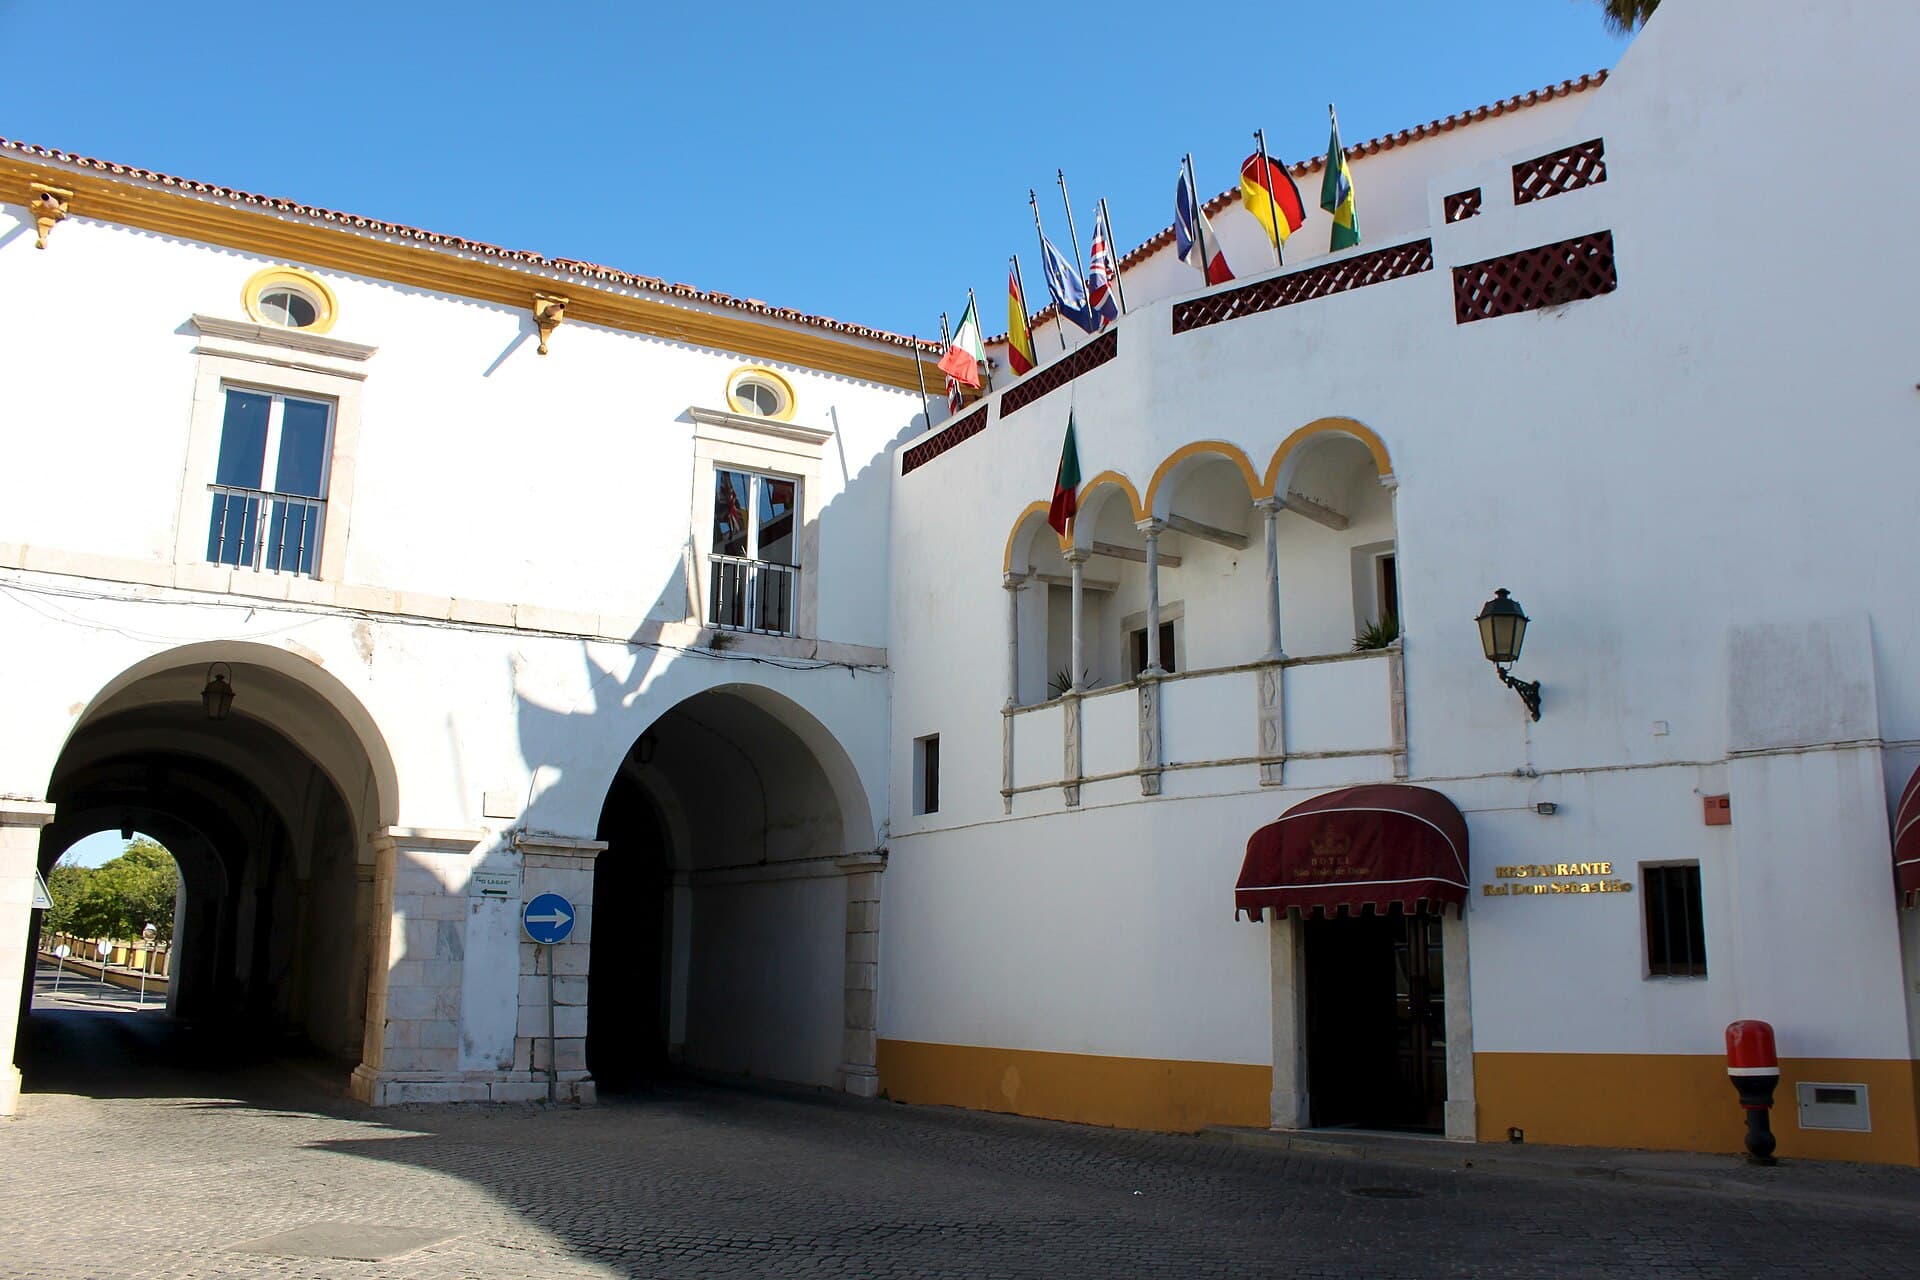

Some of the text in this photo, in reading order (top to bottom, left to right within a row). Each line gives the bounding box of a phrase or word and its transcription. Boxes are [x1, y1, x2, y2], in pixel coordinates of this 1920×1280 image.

[1311, 856, 1351, 865] HOTEL
[1496, 861, 1612, 878] RESTAURANTE
[1483, 878, 1633, 896] Rei Dom Sebastião
